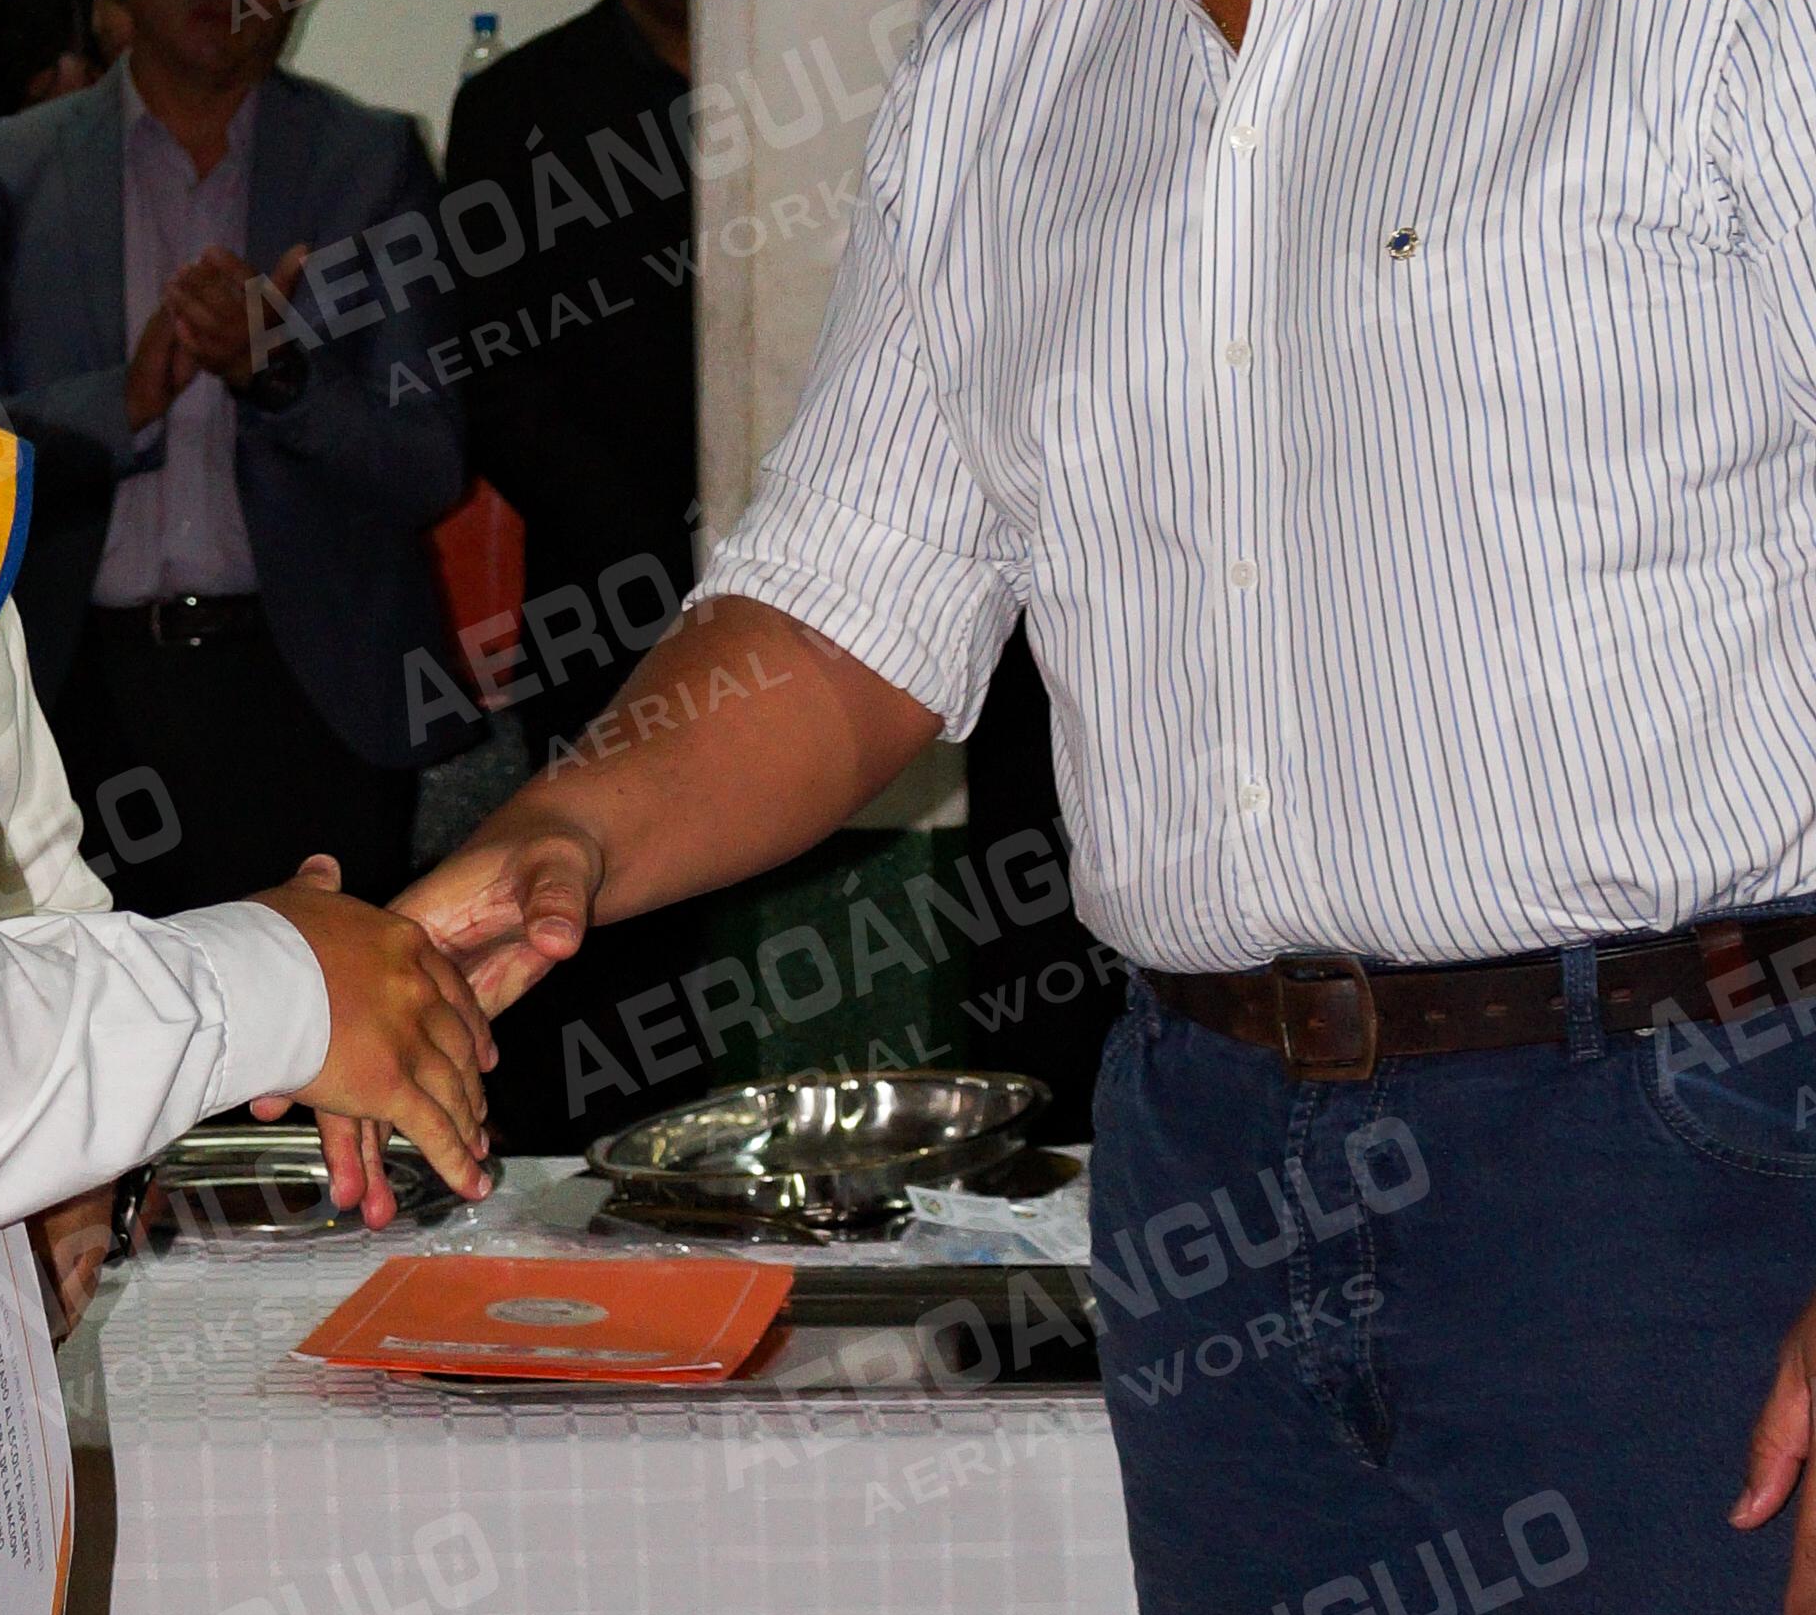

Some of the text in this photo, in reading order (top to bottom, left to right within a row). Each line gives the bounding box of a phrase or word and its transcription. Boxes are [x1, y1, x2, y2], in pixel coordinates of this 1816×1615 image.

[4, 1406, 13, 1426] AL
[0, 1456, 8, 1478] DE
[6, 1426, 23, 1494] ESCOLTA
[2, 1478, 10, 1501] LA
[16, 1495, 32, 1570] SUPLENTE
